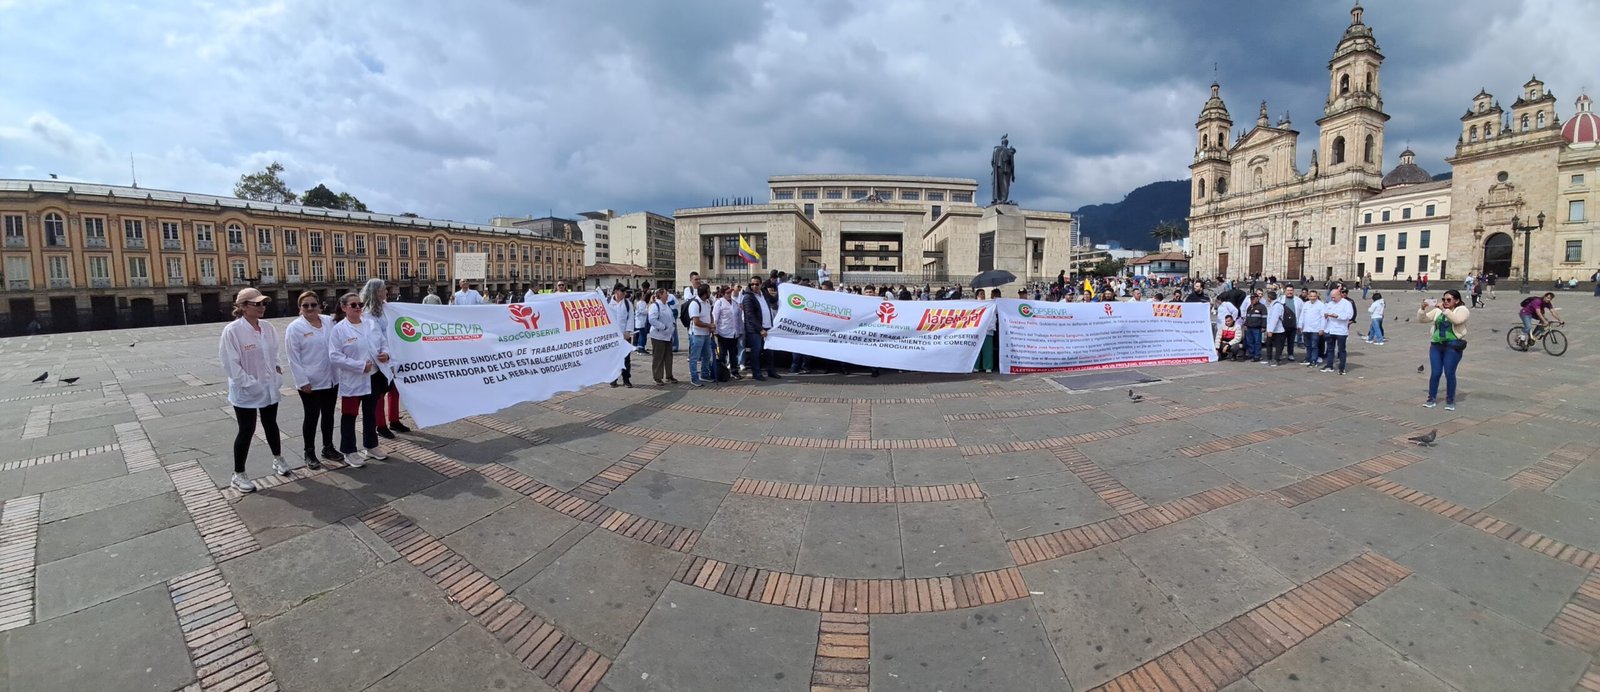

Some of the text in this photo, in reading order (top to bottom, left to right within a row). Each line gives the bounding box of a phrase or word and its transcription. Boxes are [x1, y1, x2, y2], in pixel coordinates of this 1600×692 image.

[787, 293, 852, 316] COPSERVIR
[395, 316, 483, 342] COPSERVIR
[397, 357, 469, 373] ASOCOPSERVIR
[470, 350, 513, 364] SINDICATO
[517, 347, 527, 356] DE
[531, 340, 583, 356] TRABAJADORES
[585, 337, 592, 345] DE
[403, 340, 620, 384] ADMINISTRADORA DE LOS ESTABLECIMIENTOS DE COMERCIO
[483, 376, 495, 385] DE
[496, 373, 508, 382] LA
[508, 367, 539, 380] REBAJA
